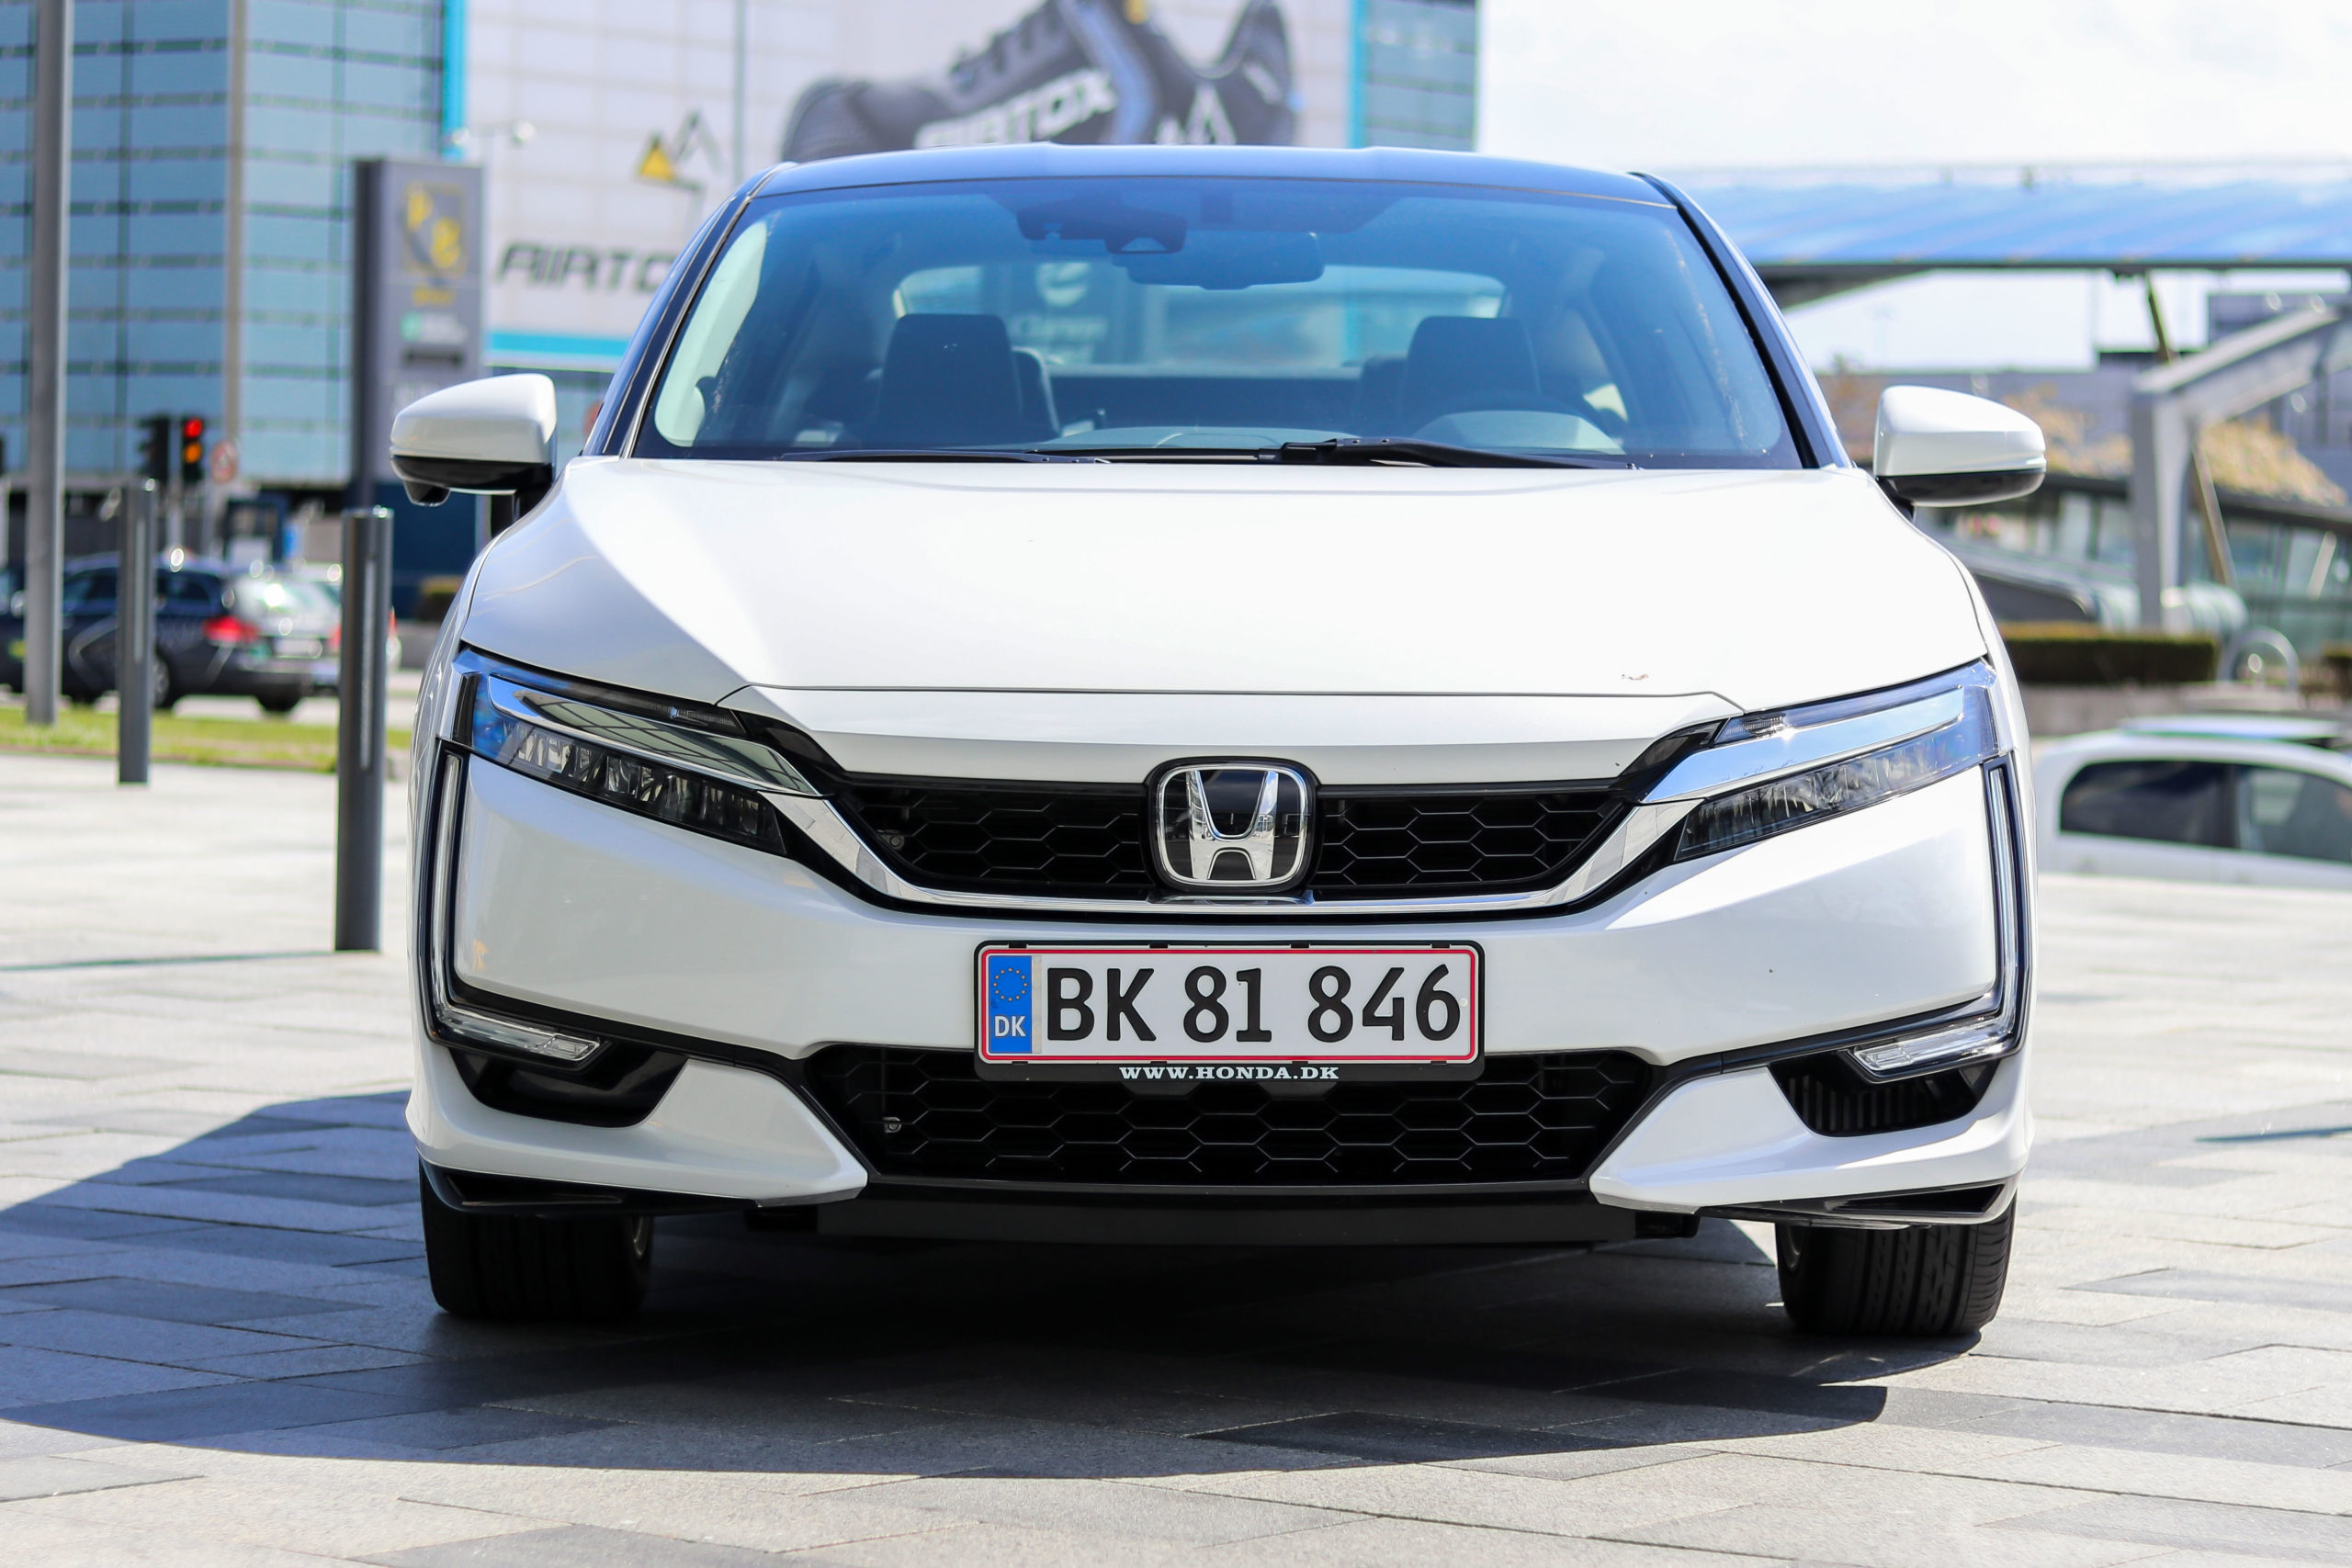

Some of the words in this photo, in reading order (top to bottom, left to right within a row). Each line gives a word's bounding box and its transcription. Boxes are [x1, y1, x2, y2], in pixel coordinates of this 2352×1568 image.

[1046, 967, 1157, 1042] BK
[1182, 965, 1272, 1043] 81
[1307, 964, 1461, 1043] 846
[993, 1015, 1026, 1038] DK
[1119, 1066, 1340, 1080] WWW.HONDA.DK
